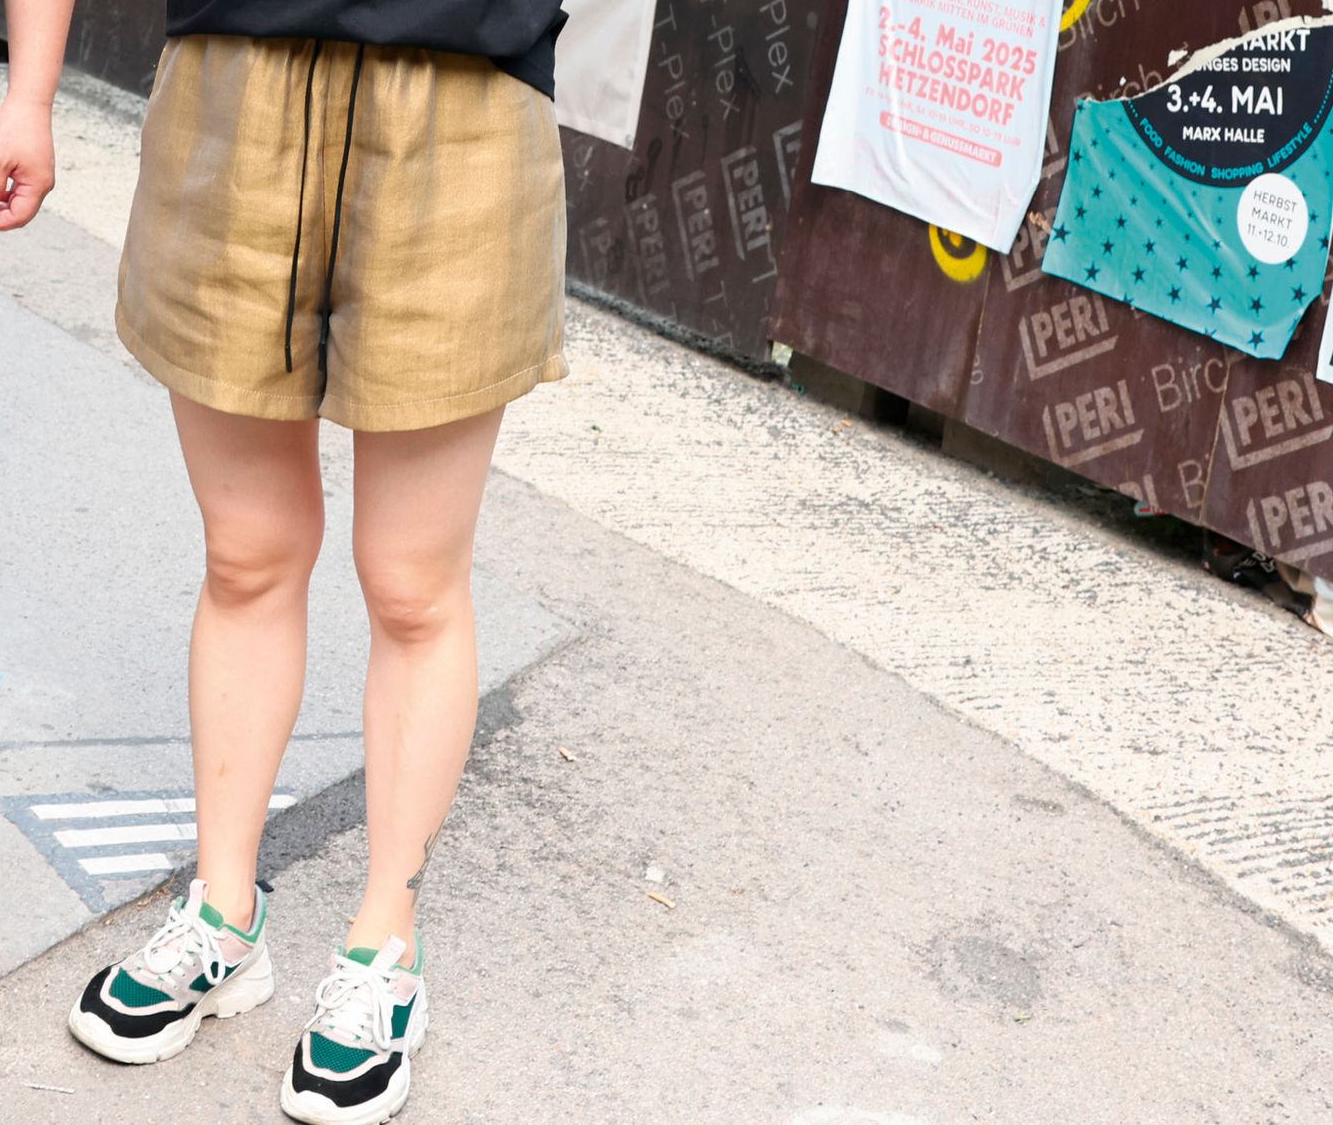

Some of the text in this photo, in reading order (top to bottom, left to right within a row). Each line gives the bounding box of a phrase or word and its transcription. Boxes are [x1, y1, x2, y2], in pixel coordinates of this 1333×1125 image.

[878, 6, 1038, 75] 2.-4. Mai 2025
[1004, 6, 1037, 25] MUSIK
[877, 63, 1015, 126] HETZENDORF
[878, 34, 1026, 102] SCHLOSSPARK
[1241, 57, 1291, 73] DESIGN
[1166, 84, 1284, 115] 3.+4. MAI
[1139, 117, 1313, 180] FOOD FASHION SHOPPING LIFESTYLE
[1182, 126, 1265, 144] MARX HALLE
[684, 185, 720, 275] PERI
[733, 158, 771, 253] PERI
[1251, 206, 1293, 231] MARKT
[1253, 190, 1298, 214] HERBST
[1032, 297, 1108, 358] PERI
[1055, 380, 1135, 448] PERI
[1233, 372, 1325, 447] PERI
